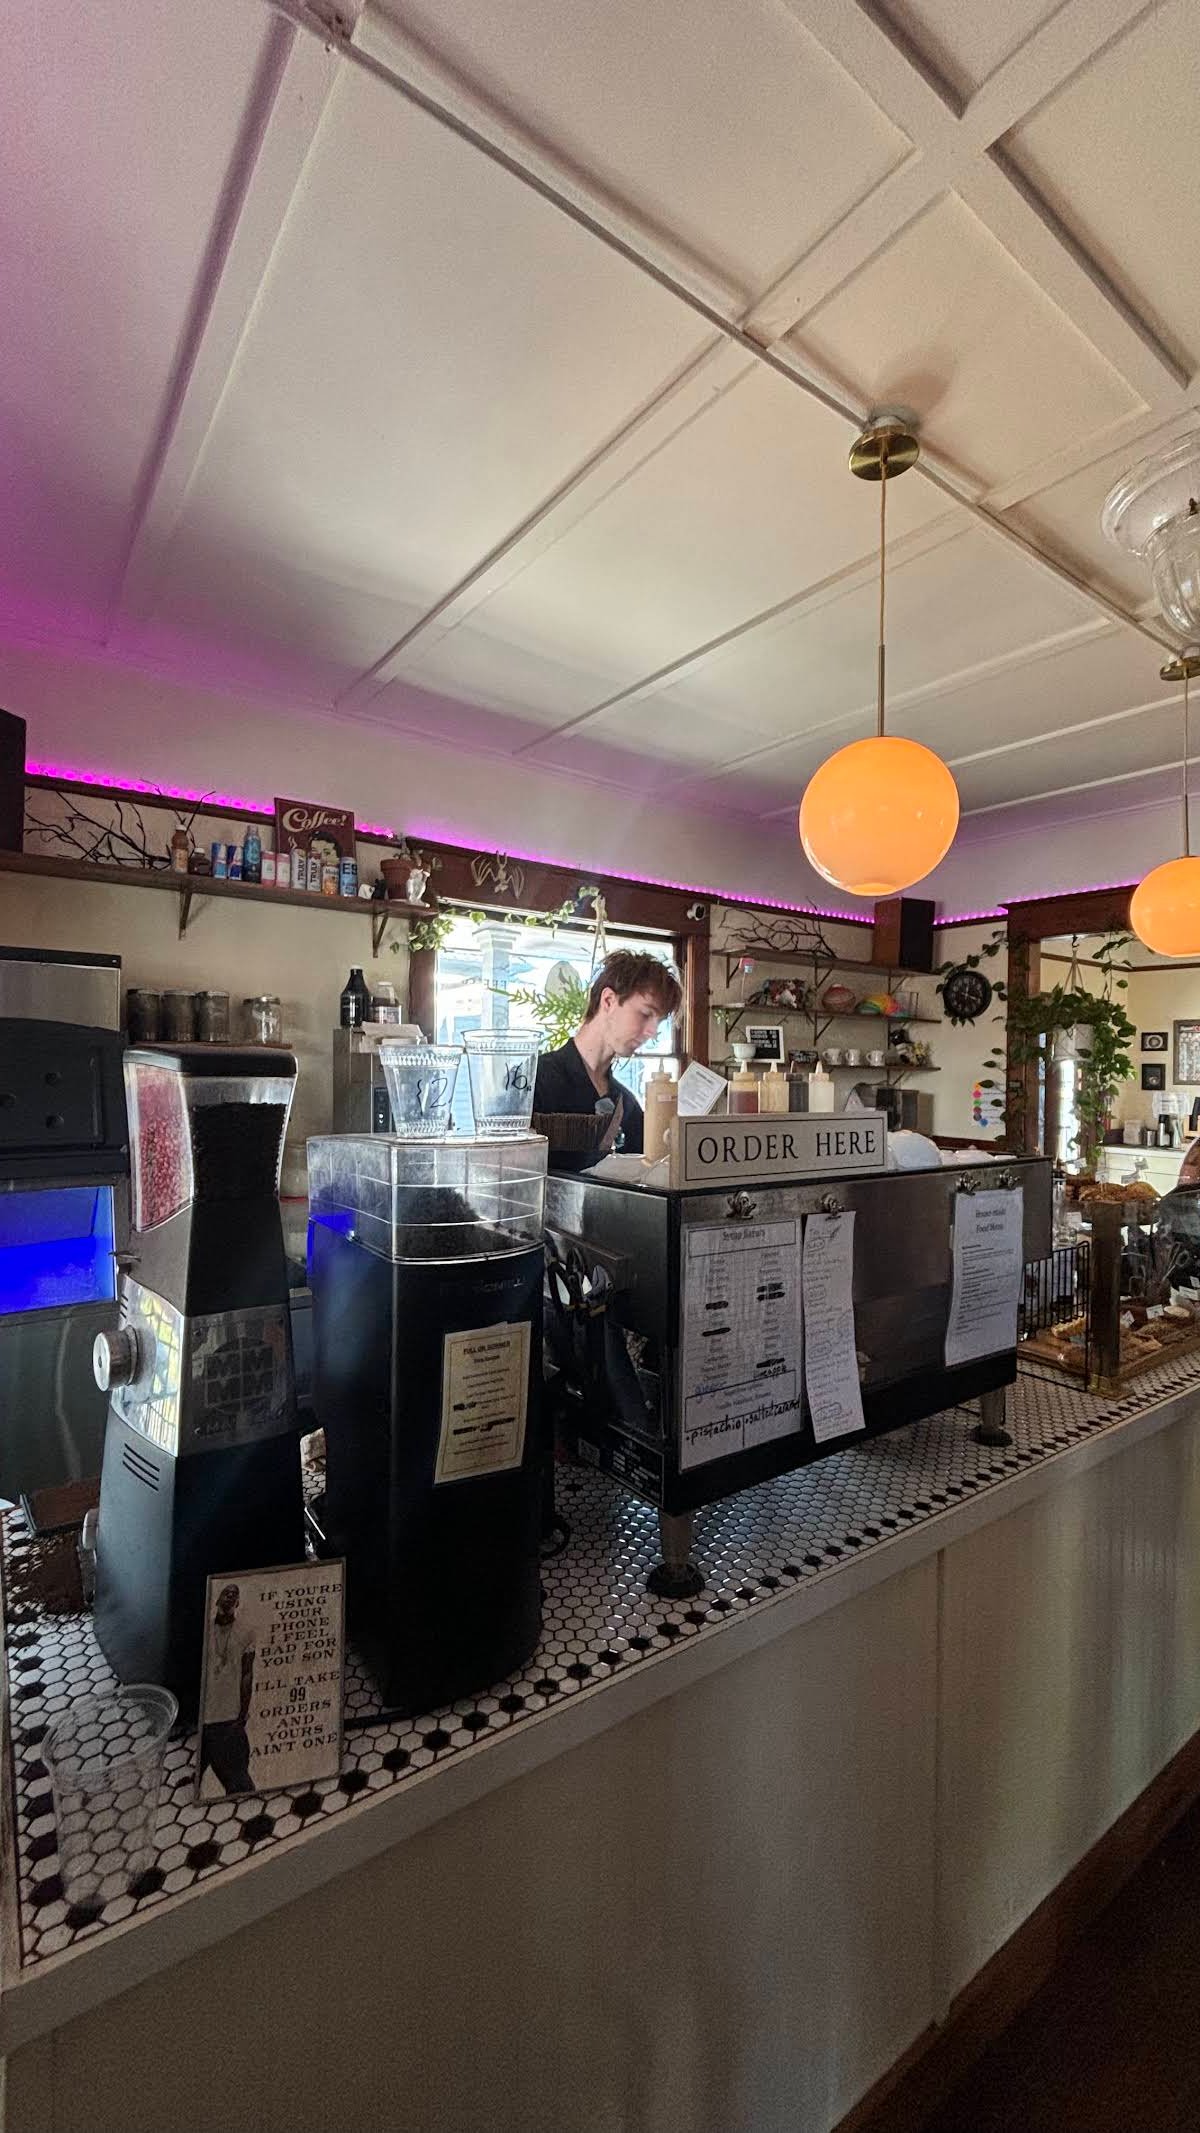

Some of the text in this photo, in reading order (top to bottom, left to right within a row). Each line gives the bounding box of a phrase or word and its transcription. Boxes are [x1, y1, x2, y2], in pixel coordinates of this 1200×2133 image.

[282, 807, 347, 833] Coffee!
[310, 861, 318, 883] TRULY
[698, 1130, 876, 1164] ORDER HERE
[690, 1414, 741, 1446] pistachio
[260, 1583, 342, 1601] IF YOU'RE
[275, 1596, 326, 1610] USING
[278, 1607, 322, 1620] YOUR
[271, 1617, 329, 1633] PHONE
[271, 1629, 329, 1645] I FEEL
[261, 1638, 336, 1657] BAD FOR
[263, 1649, 335, 1668] YOU SON
[255, 1671, 340, 1692] I'LL TAKE
[290, 1687, 306, 1702] 99
[260, 1700, 331, 1718] ORDERS
[277, 1714, 314, 1728] AND
[266, 1724, 323, 1742] YOURS
[250, 1733, 337, 1757] AIN'T ONE
